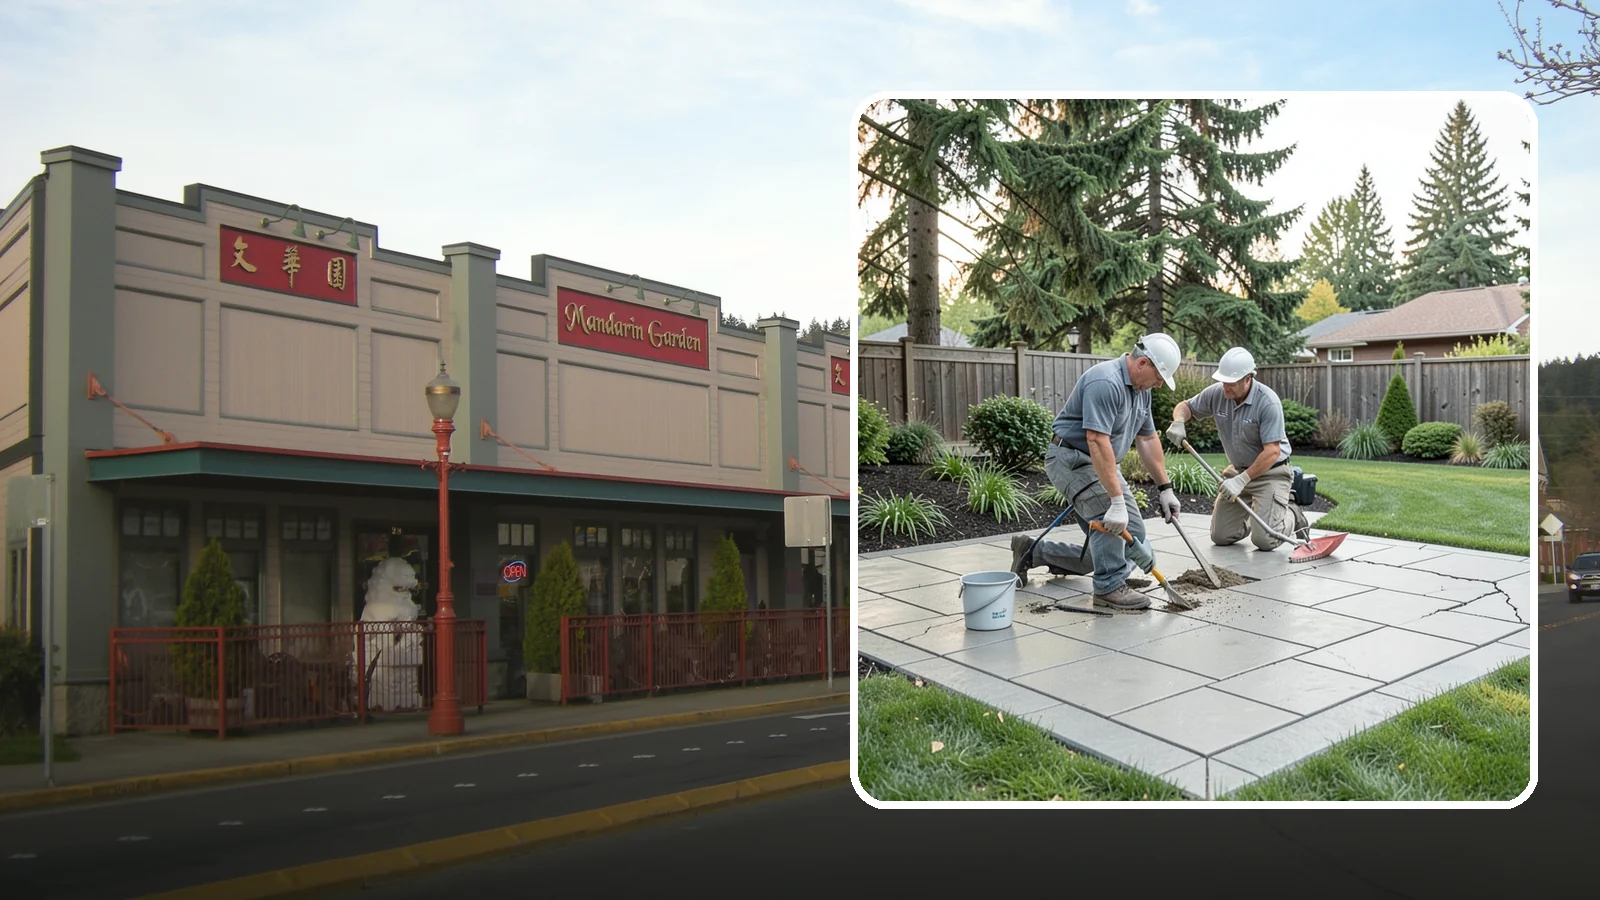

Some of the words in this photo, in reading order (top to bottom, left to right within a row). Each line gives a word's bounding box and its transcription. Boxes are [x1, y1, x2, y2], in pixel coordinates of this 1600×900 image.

[231, 235, 346, 290] 文華園
[564, 302, 644, 341] Mandarin
[647, 320, 701, 352] Garden
[503, 565, 527, 578] OPEN
